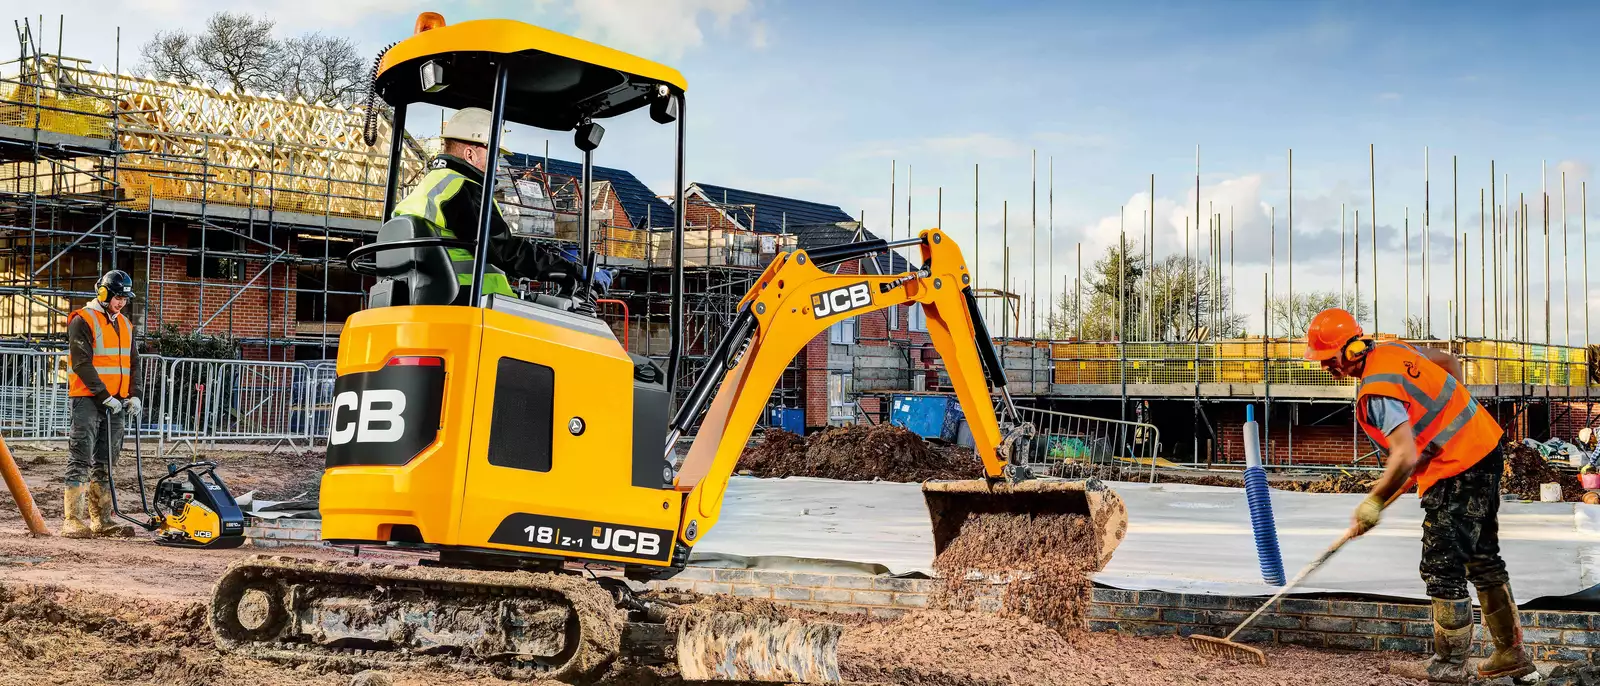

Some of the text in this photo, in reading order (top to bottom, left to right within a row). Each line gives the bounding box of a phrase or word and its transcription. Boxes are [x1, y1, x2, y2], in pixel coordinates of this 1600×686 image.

[814, 284, 871, 317] JCB
[327, 389, 407, 447] CB
[524, 525, 553, 544] 18
[591, 527, 660, 555] JCB
